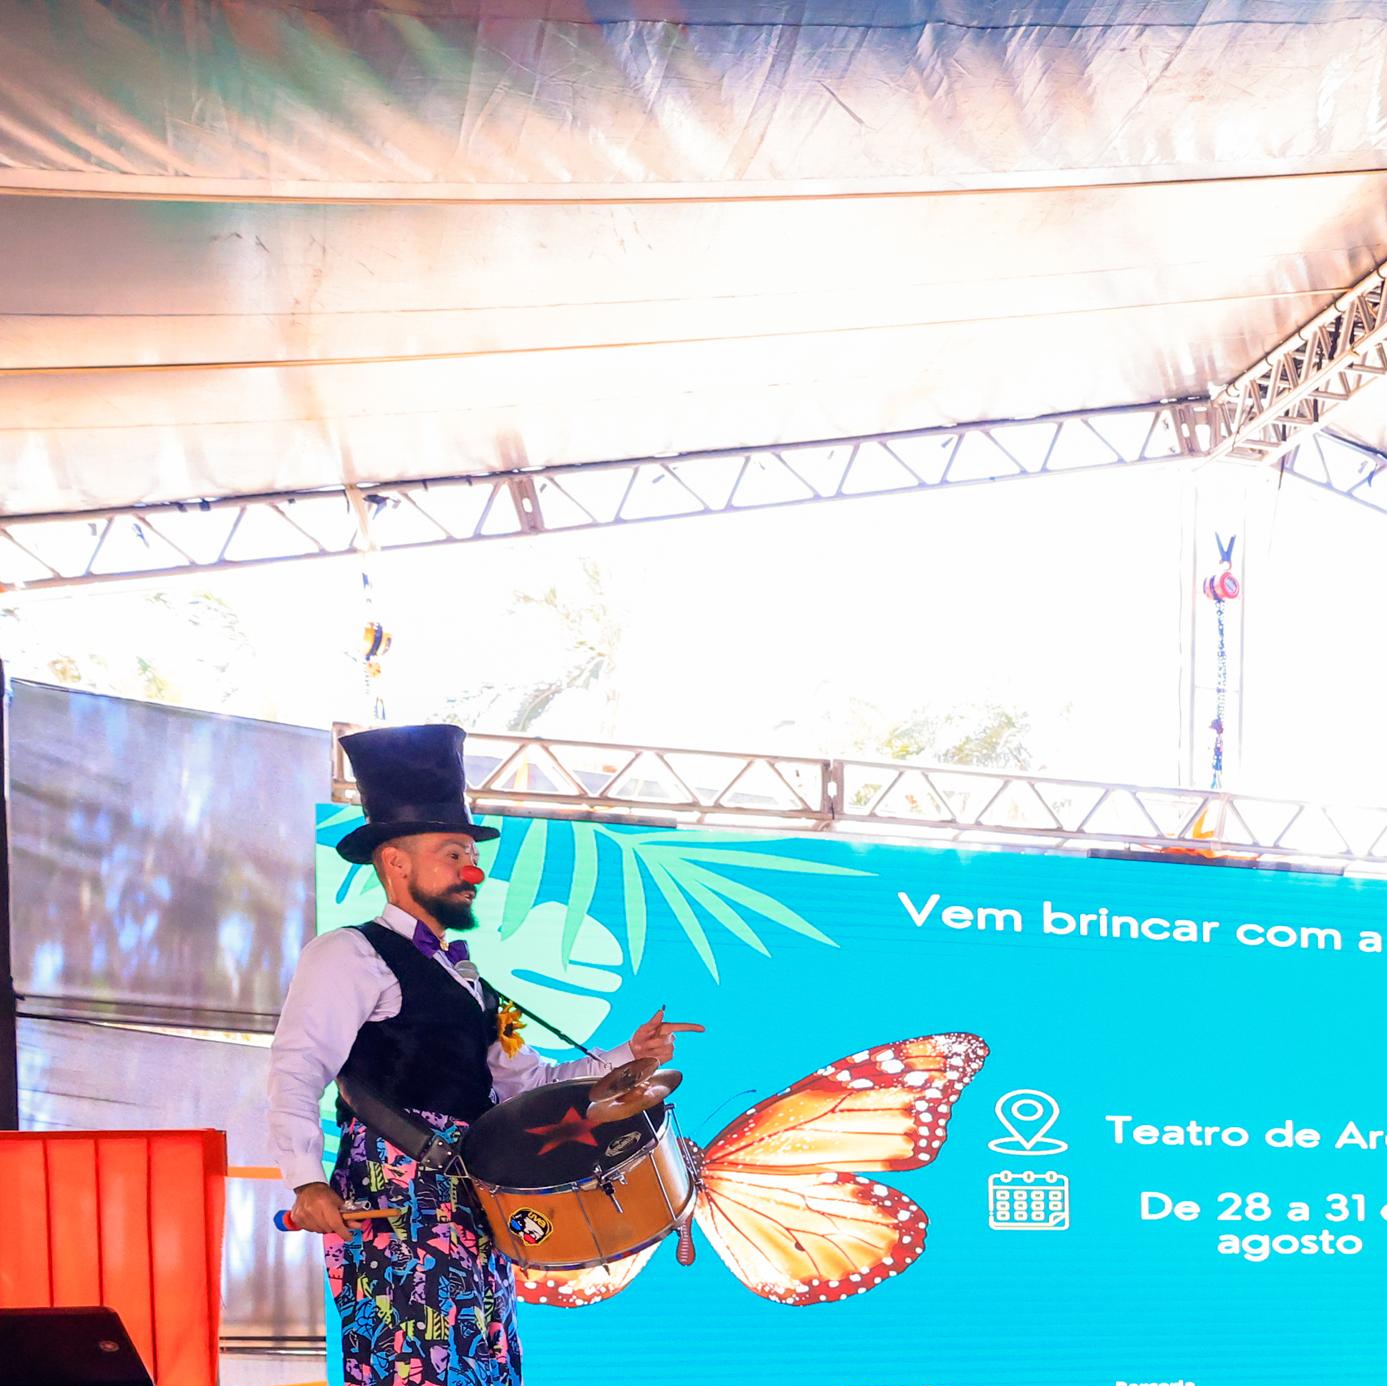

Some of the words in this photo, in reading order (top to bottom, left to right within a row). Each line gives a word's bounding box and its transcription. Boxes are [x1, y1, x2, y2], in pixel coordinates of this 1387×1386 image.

[898, 892, 1022, 931] Vem
[1044, 901, 1219, 942] brincar
[1236, 924, 1341, 950] com
[1359, 931, 1382, 952] a
[1106, 1116, 1248, 1146] Teatro
[1265, 1120, 1320, 1148] de
[1141, 1192, 1200, 1220] De
[1218, 1192, 1271, 1221] 28
[1288, 1202, 1309, 1221] a
[1326, 1194, 1365, 1222] 31
[1218, 1230, 1362, 1262] agosto
